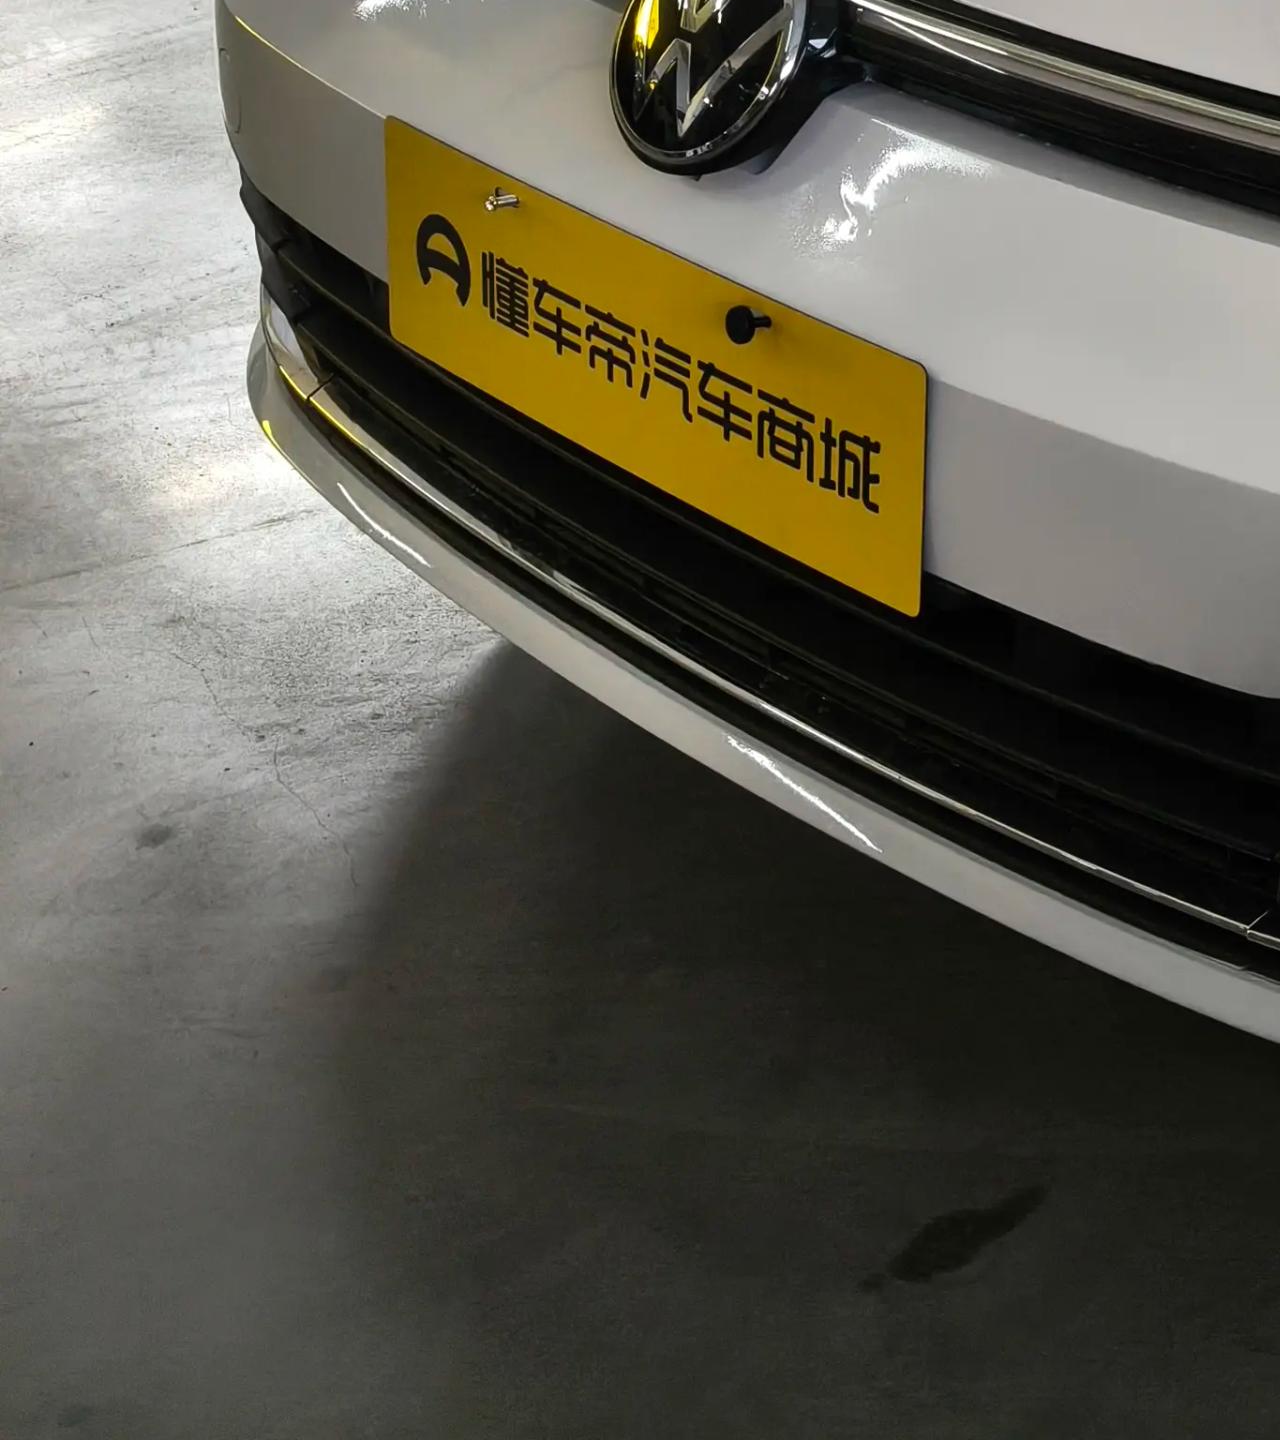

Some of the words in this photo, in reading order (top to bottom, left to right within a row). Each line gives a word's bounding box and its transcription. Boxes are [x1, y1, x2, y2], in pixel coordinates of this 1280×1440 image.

[481, 250, 880, 513] 懂车帝汽车商城
